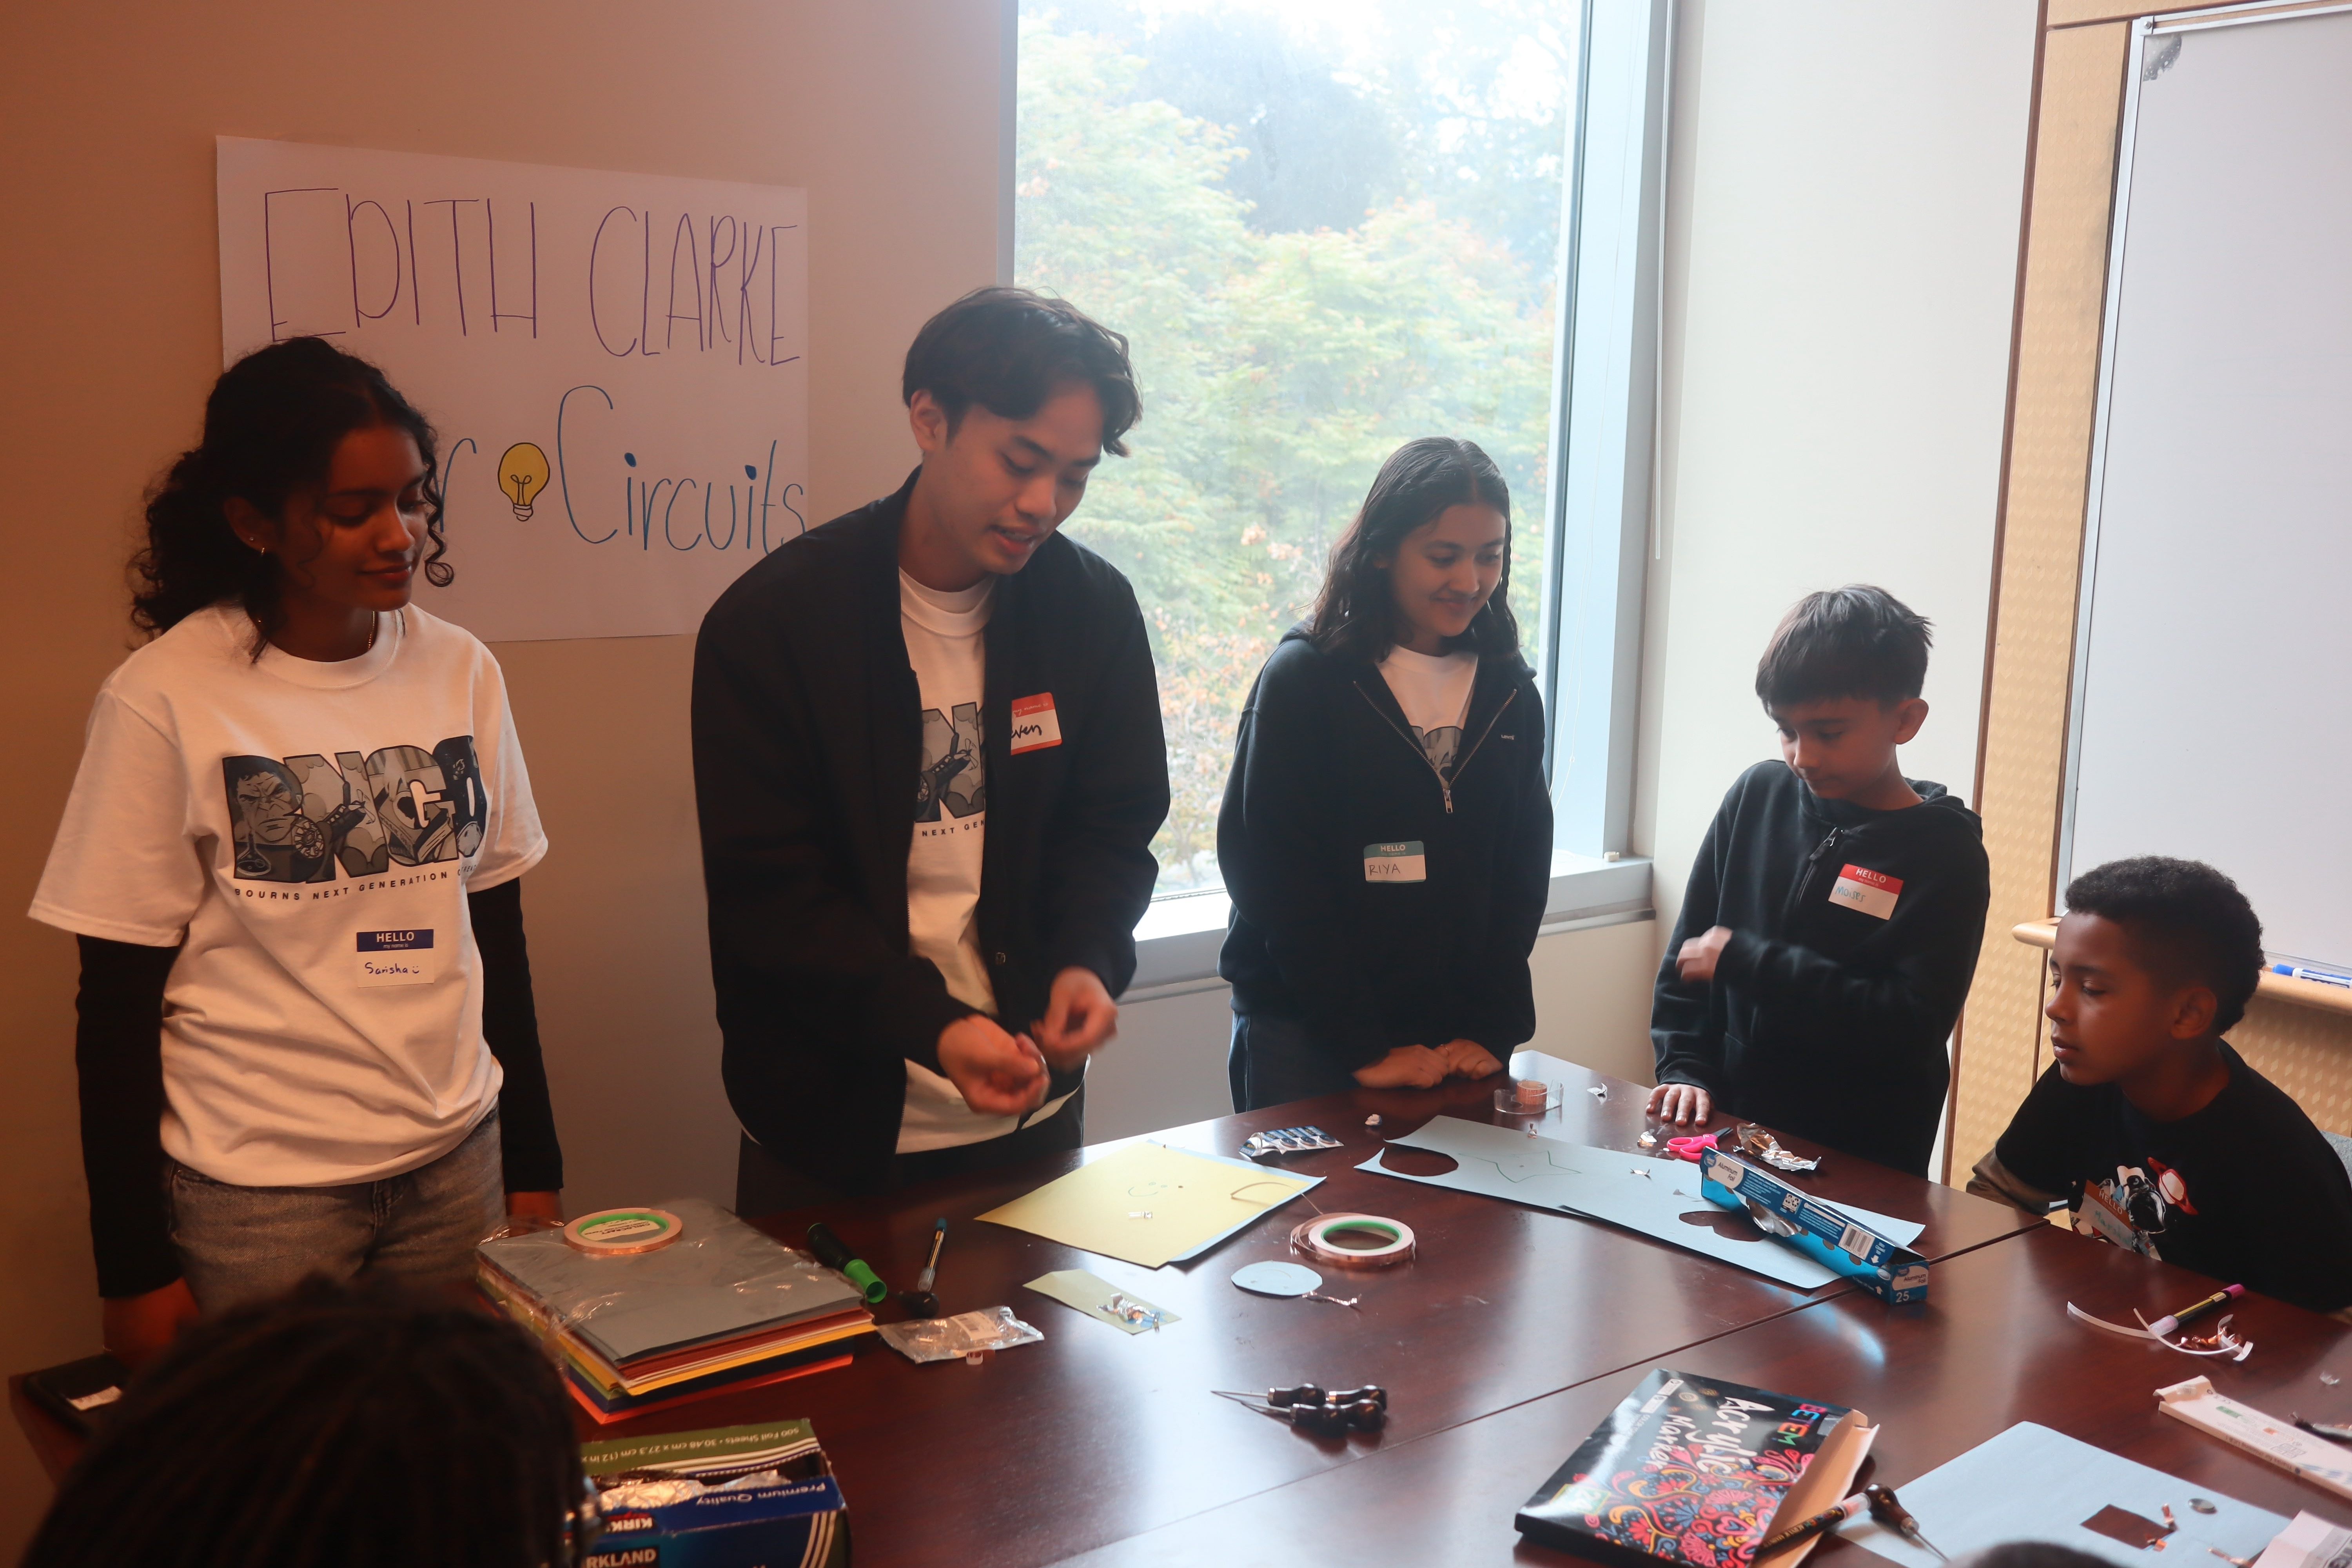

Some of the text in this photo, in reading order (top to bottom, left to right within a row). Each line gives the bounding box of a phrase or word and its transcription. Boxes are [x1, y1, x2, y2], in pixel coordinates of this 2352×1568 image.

[264, 188, 800, 365] EDITH CLARKE
[557, 385, 805, 554] Circuits
[922, 827, 955, 837] NEXT
[1368, 863, 1401, 876] RIYA
[1855, 868, 1886, 884] HELLO
[235, 888, 301, 901] BOURNS
[313, 887, 350, 900] NEXT
[359, 871, 448, 892] GENERATION
[376, 931, 414, 943] HELLO
[365, 962, 408, 975] Sarisha
[1717, 1161, 1738, 1176] Aluminum
[1727, 1174, 1736, 1183] Foil
[2098, 1191, 2123, 1215] HELLO
[602, 1223, 650, 1235] CHILDCRAFT
[1896, 1291, 1909, 1303] 25
[725, 1432, 760, 1446] Sheets
[761, 1430, 779, 1442] Foil
[1644, 1414, 1693, 1468] Marker
[1685, 1396, 1775, 1475] Acrylic
[639, 1445, 663, 1456] 27.3
[671, 1442, 688, 1450] cm
[689, 1438, 718, 1451] 30.48
[589, 1454, 601, 1463] in
[603, 1450, 619, 1462] (12
[621, 1448, 637, 1458] cm
[695, 1482, 826, 1507] Premium Quality
[608, 1517, 654, 1534] KIRK
[586, 1547, 657, 1568] RKLAND
